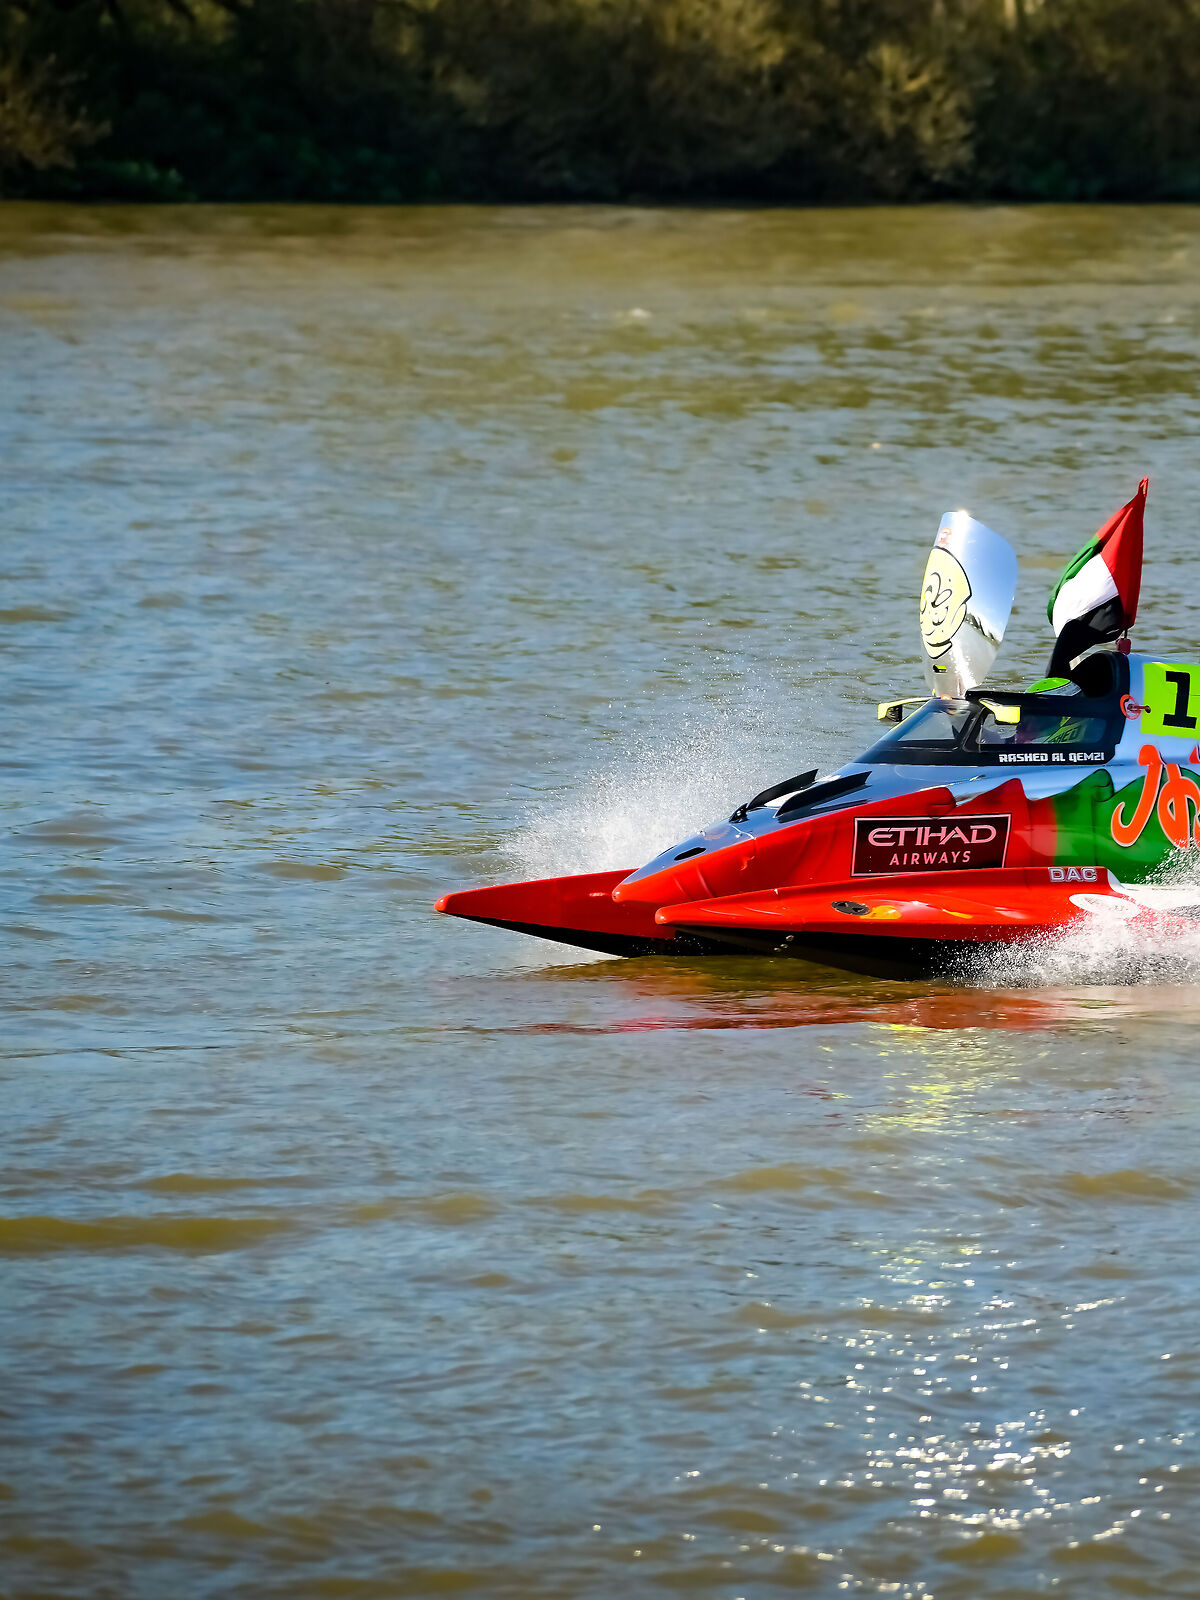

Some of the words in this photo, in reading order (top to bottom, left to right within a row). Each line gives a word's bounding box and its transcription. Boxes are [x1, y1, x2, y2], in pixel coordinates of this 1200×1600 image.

[1162, 670, 1198, 730] 1
[998, 753, 1049, 763] RASHED
[1051, 752, 1066, 762] AL
[1068, 752, 1105, 763] QEMZI
[867, 824, 997, 847] ETIHAD
[889, 850, 971, 866] AIRWAYS
[1047, 867, 1098, 882] DAC
